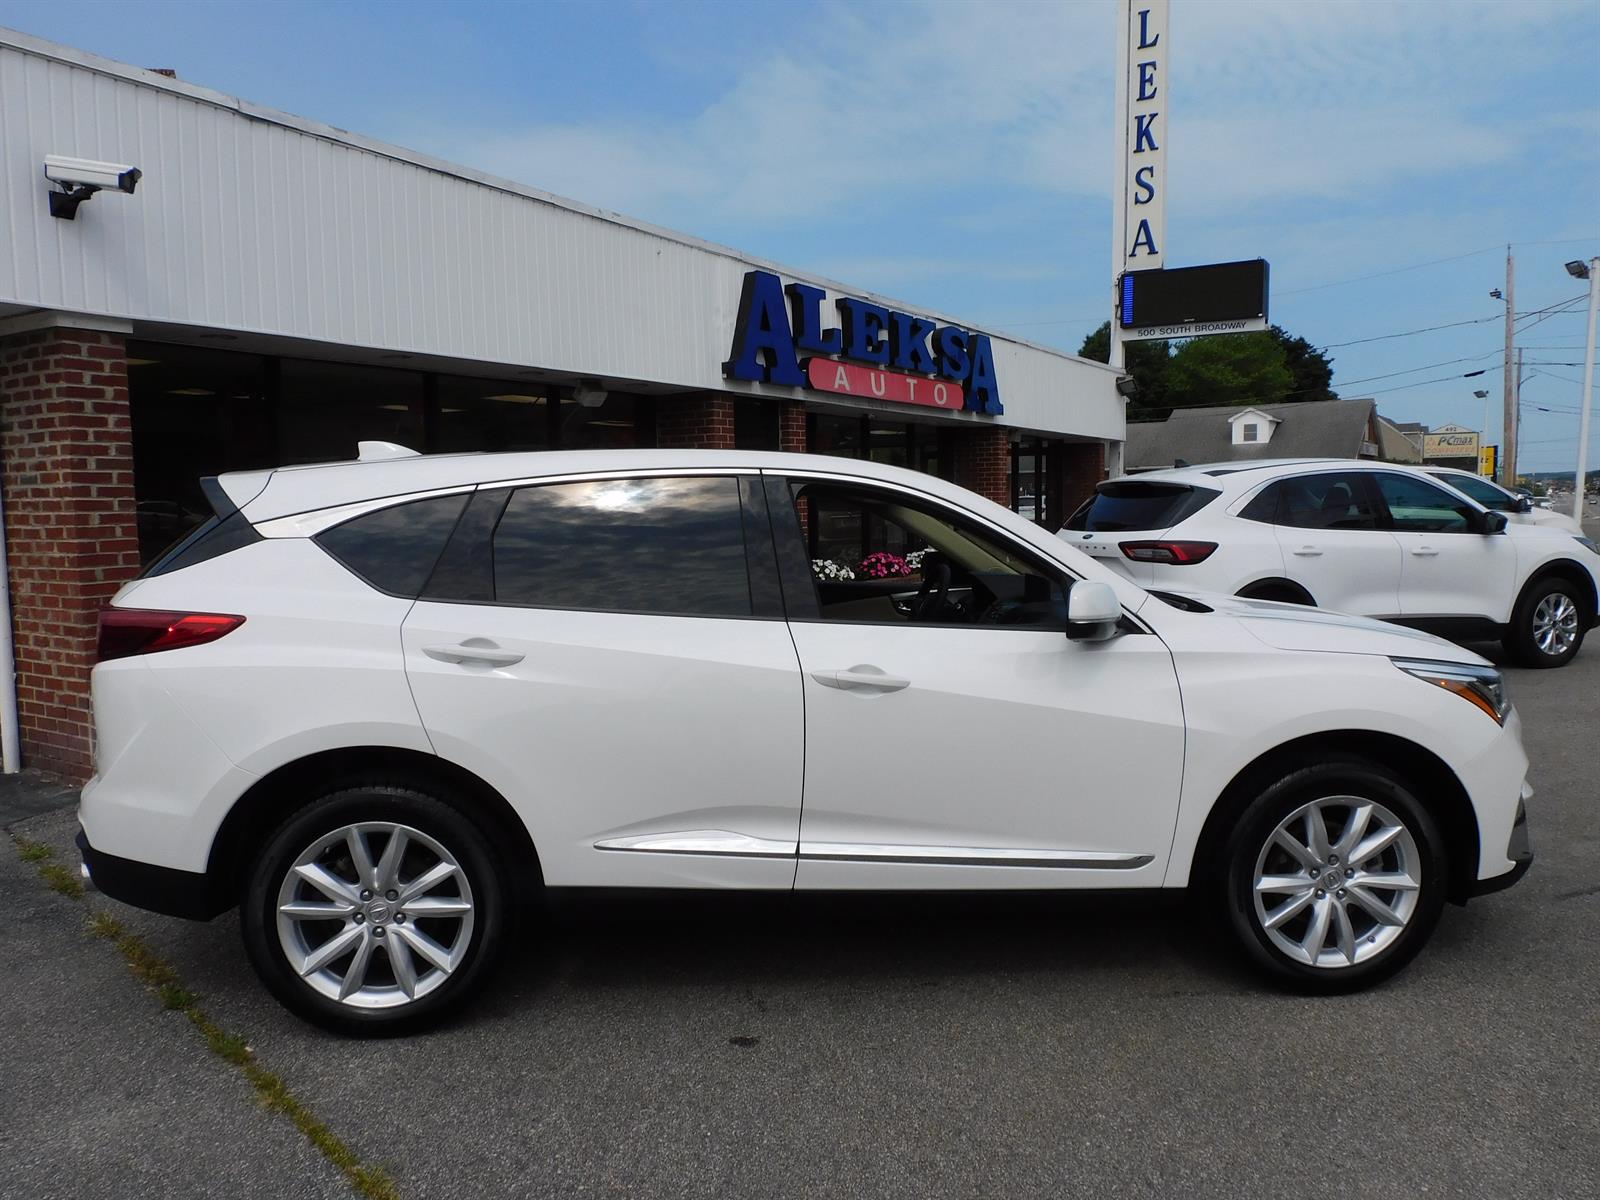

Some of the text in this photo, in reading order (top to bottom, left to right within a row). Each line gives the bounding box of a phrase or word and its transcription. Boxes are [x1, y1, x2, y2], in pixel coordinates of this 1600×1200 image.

[721, 270, 1004, 416] ALEKSA
[1137, 321, 1247, 337] 500 SOUTH BROADWAY
[833, 365, 948, 405] AUTO
